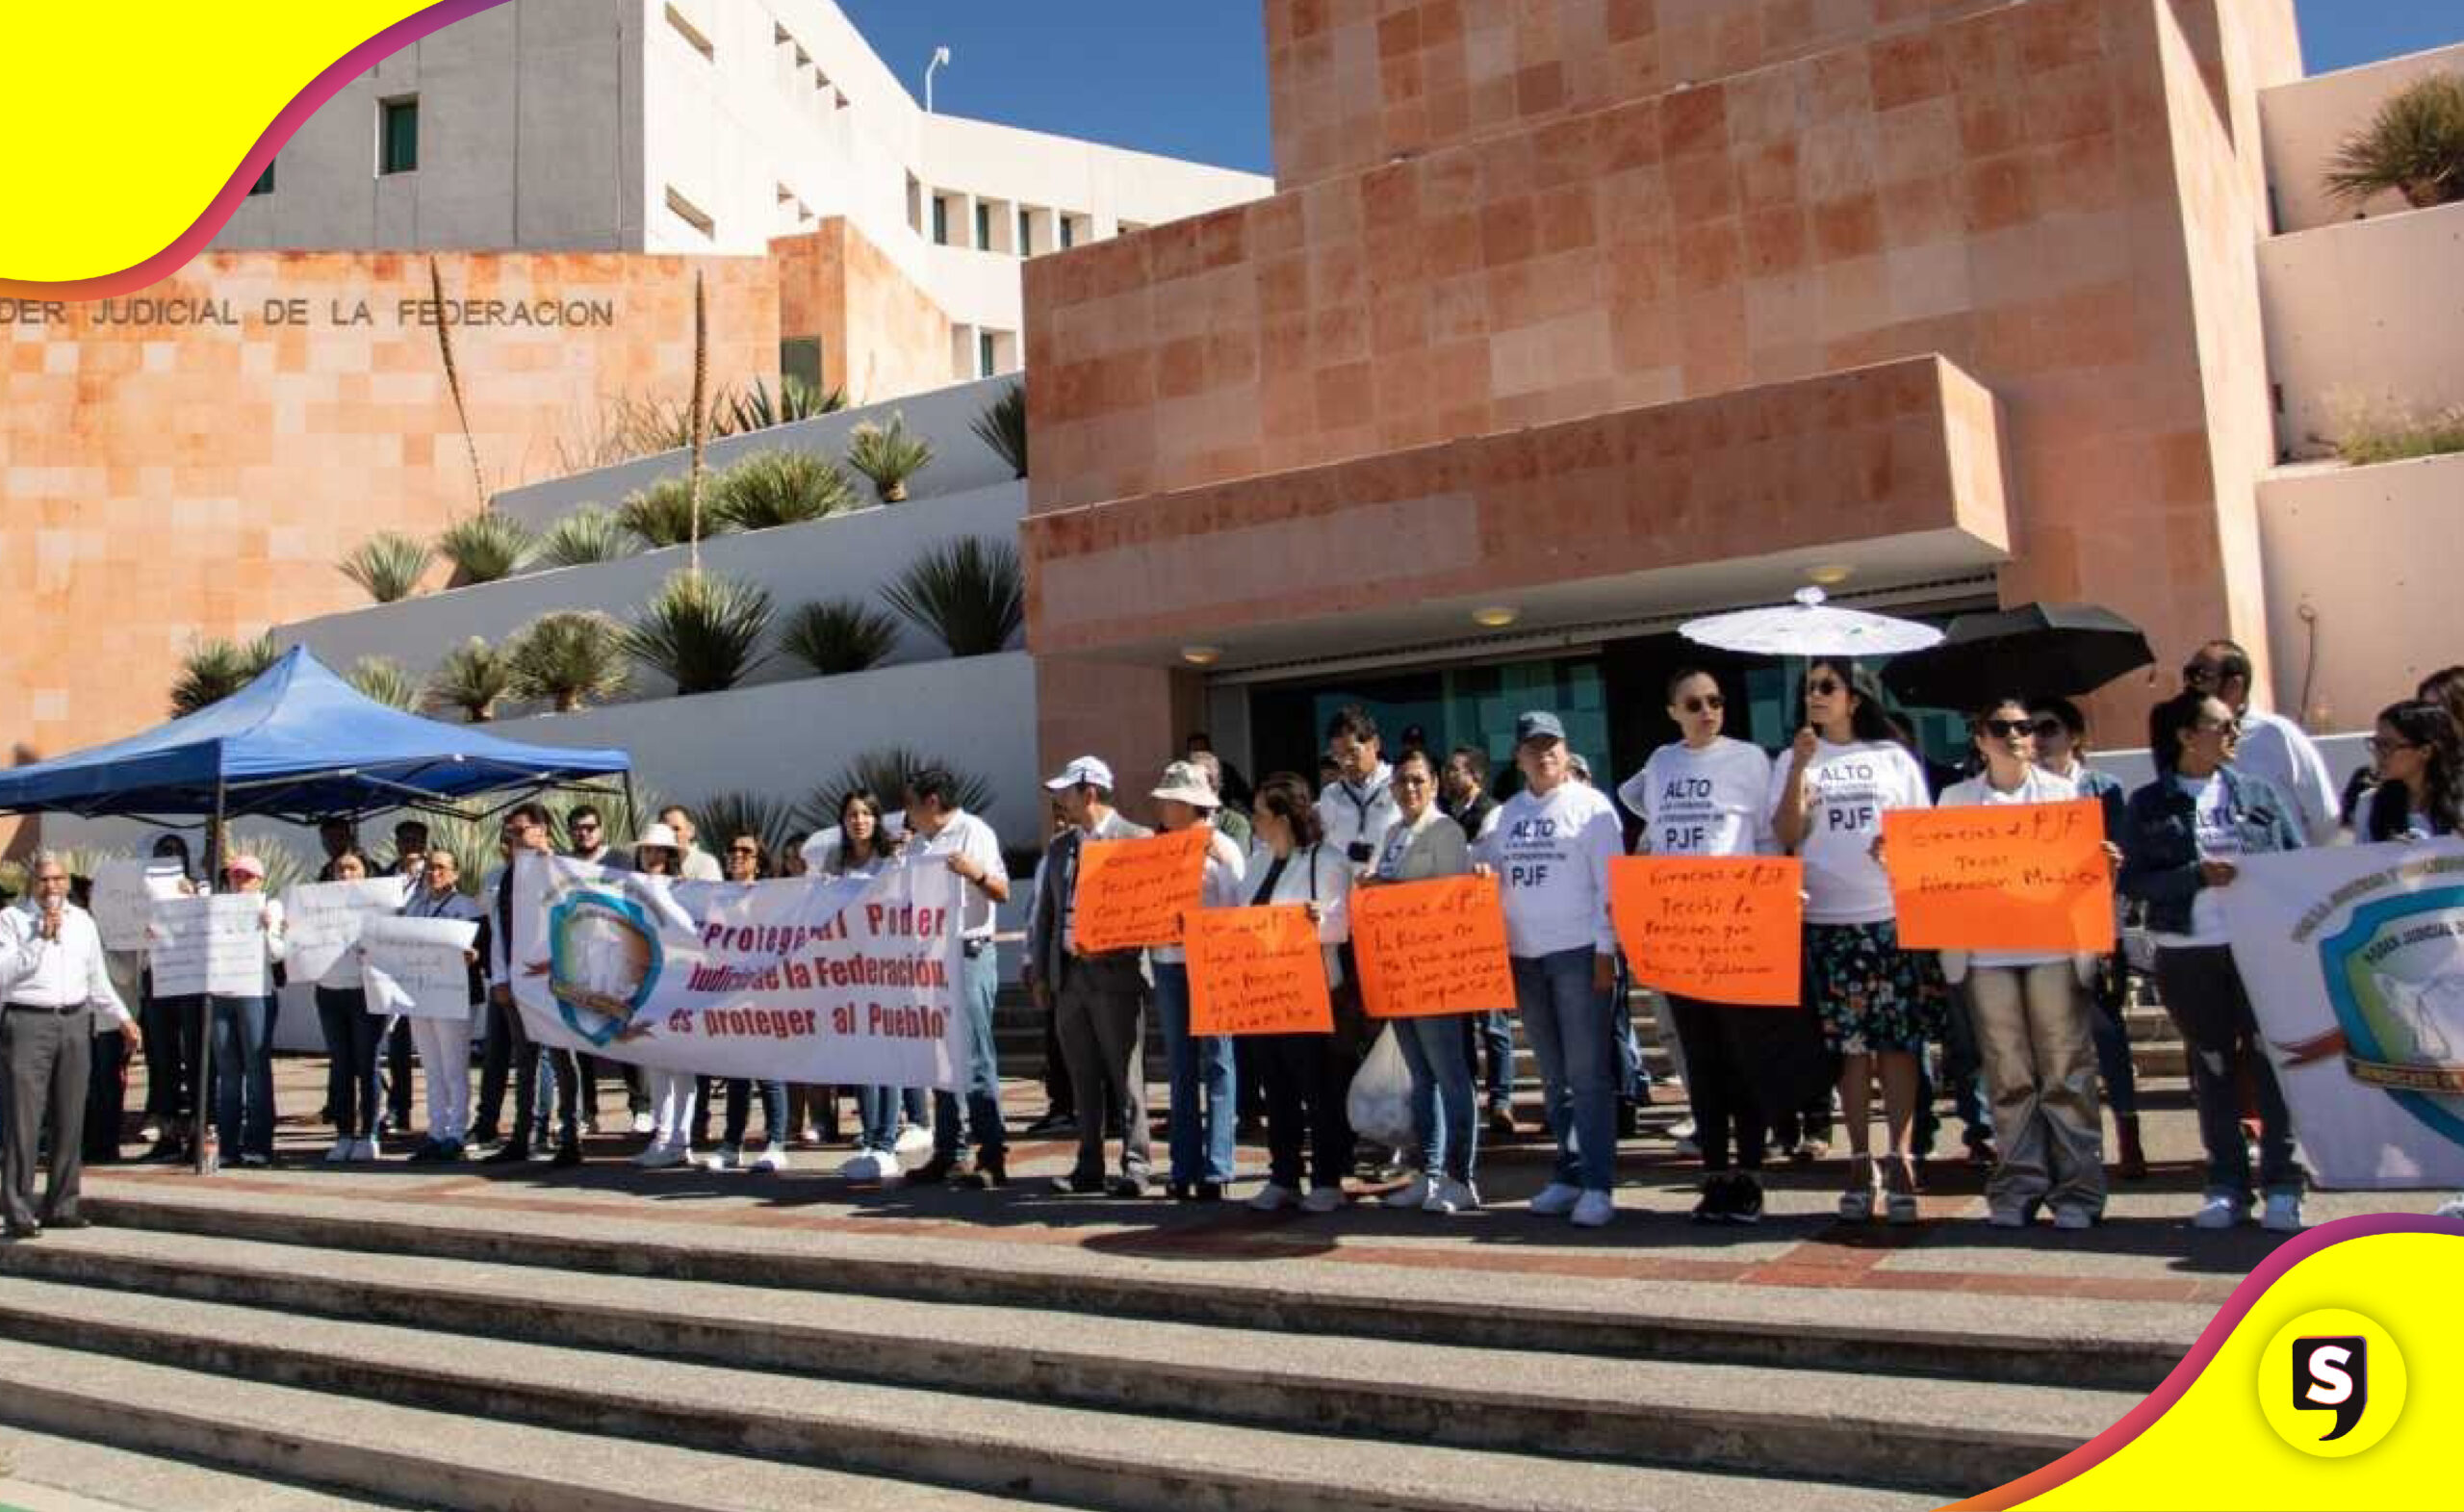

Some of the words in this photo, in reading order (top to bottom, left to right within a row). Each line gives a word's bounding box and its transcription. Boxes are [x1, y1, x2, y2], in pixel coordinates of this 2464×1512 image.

[91, 297, 239, 326] JUDICIAL
[264, 298, 308, 325] DE
[331, 298, 373, 325] LA
[397, 298, 614, 327] FEDERACION
[1819, 763, 1874, 782] ALTO
[1662, 778, 1710, 801] ALTO
[1509, 818, 1555, 839] ALTO
[1827, 806, 1873, 832] PJF
[1665, 826, 1705, 852] PJF
[1511, 863, 1549, 888] PJF
[783, 957, 812, 990] la
[668, 1007, 694, 1033] es
[704, 1007, 816, 1039] proteger
[833, 1002, 857, 1036] al
